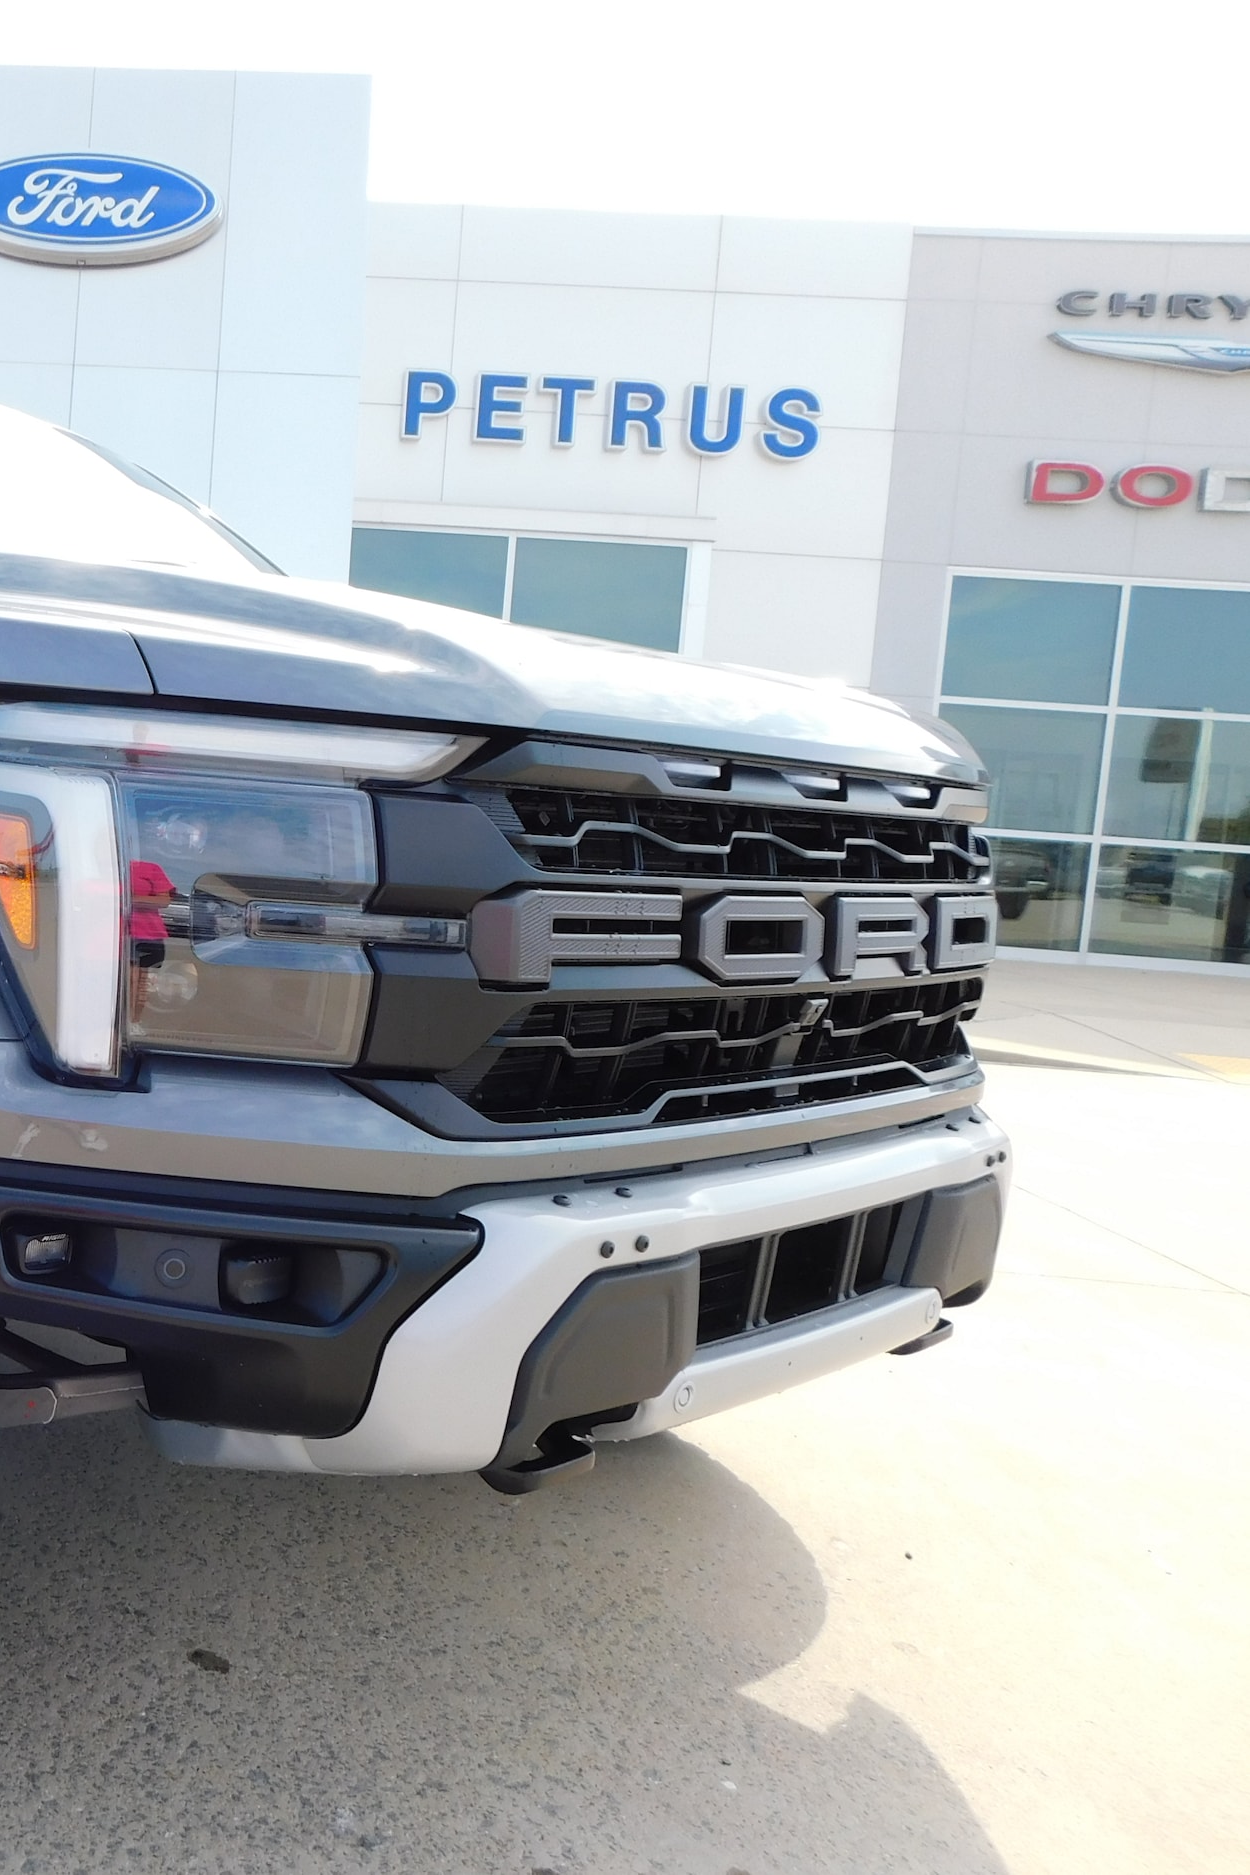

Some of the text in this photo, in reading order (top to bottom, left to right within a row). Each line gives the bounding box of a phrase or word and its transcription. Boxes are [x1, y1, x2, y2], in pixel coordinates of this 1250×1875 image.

[6, 168, 161, 229] Ford
[400, 367, 824, 462] PETRUS
[472, 888, 998, 983] FORD
